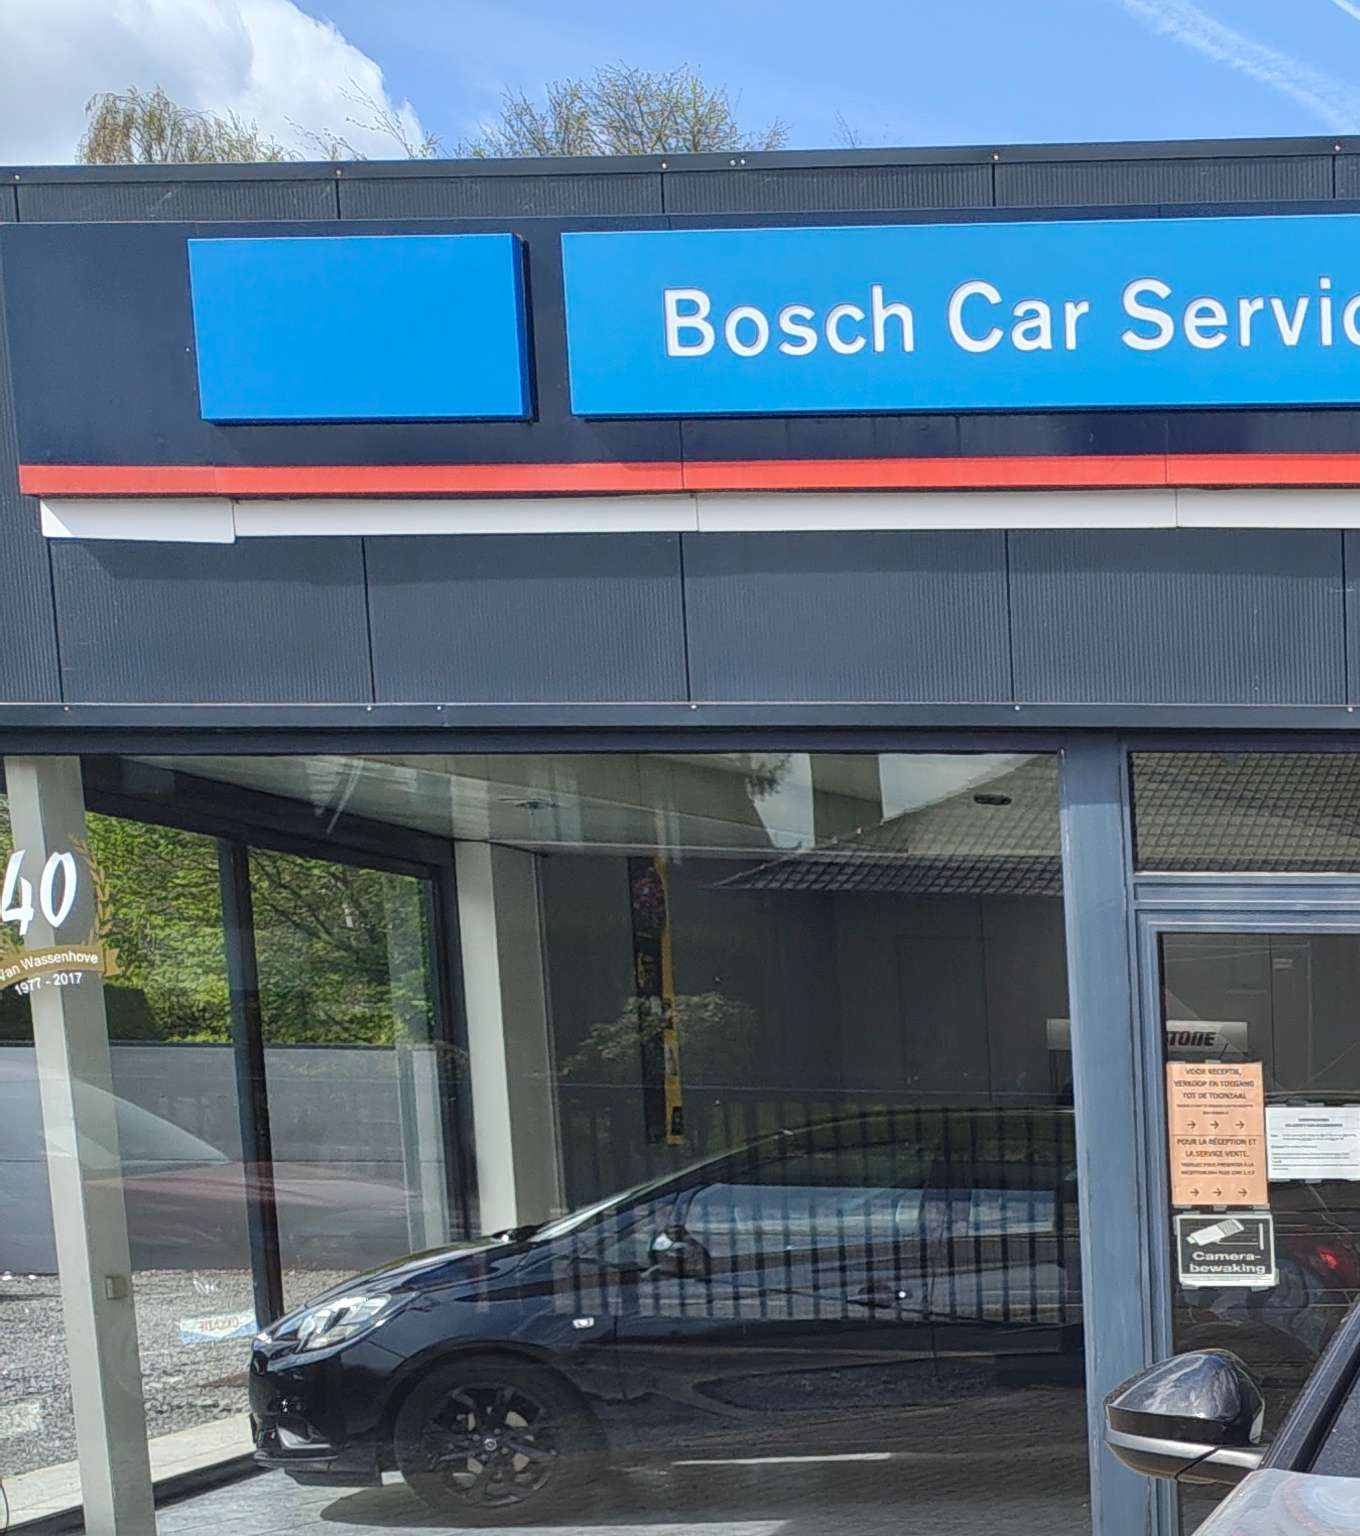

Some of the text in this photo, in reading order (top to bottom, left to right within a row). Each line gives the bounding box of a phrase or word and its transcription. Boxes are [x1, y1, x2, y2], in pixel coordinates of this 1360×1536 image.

[663, 285, 915, 358] Bosch
[947, 280, 1090, 354] Car
[0, 849, 78, 937] 40
[20, 950, 98, 971] Wassenhove
[15, 976, 42, 996] 1977
[52, 972, 82, 986] 2017
[1192, 1251, 1262, 1261] Camera-
[1189, 1263, 1267, 1275] bewaking
